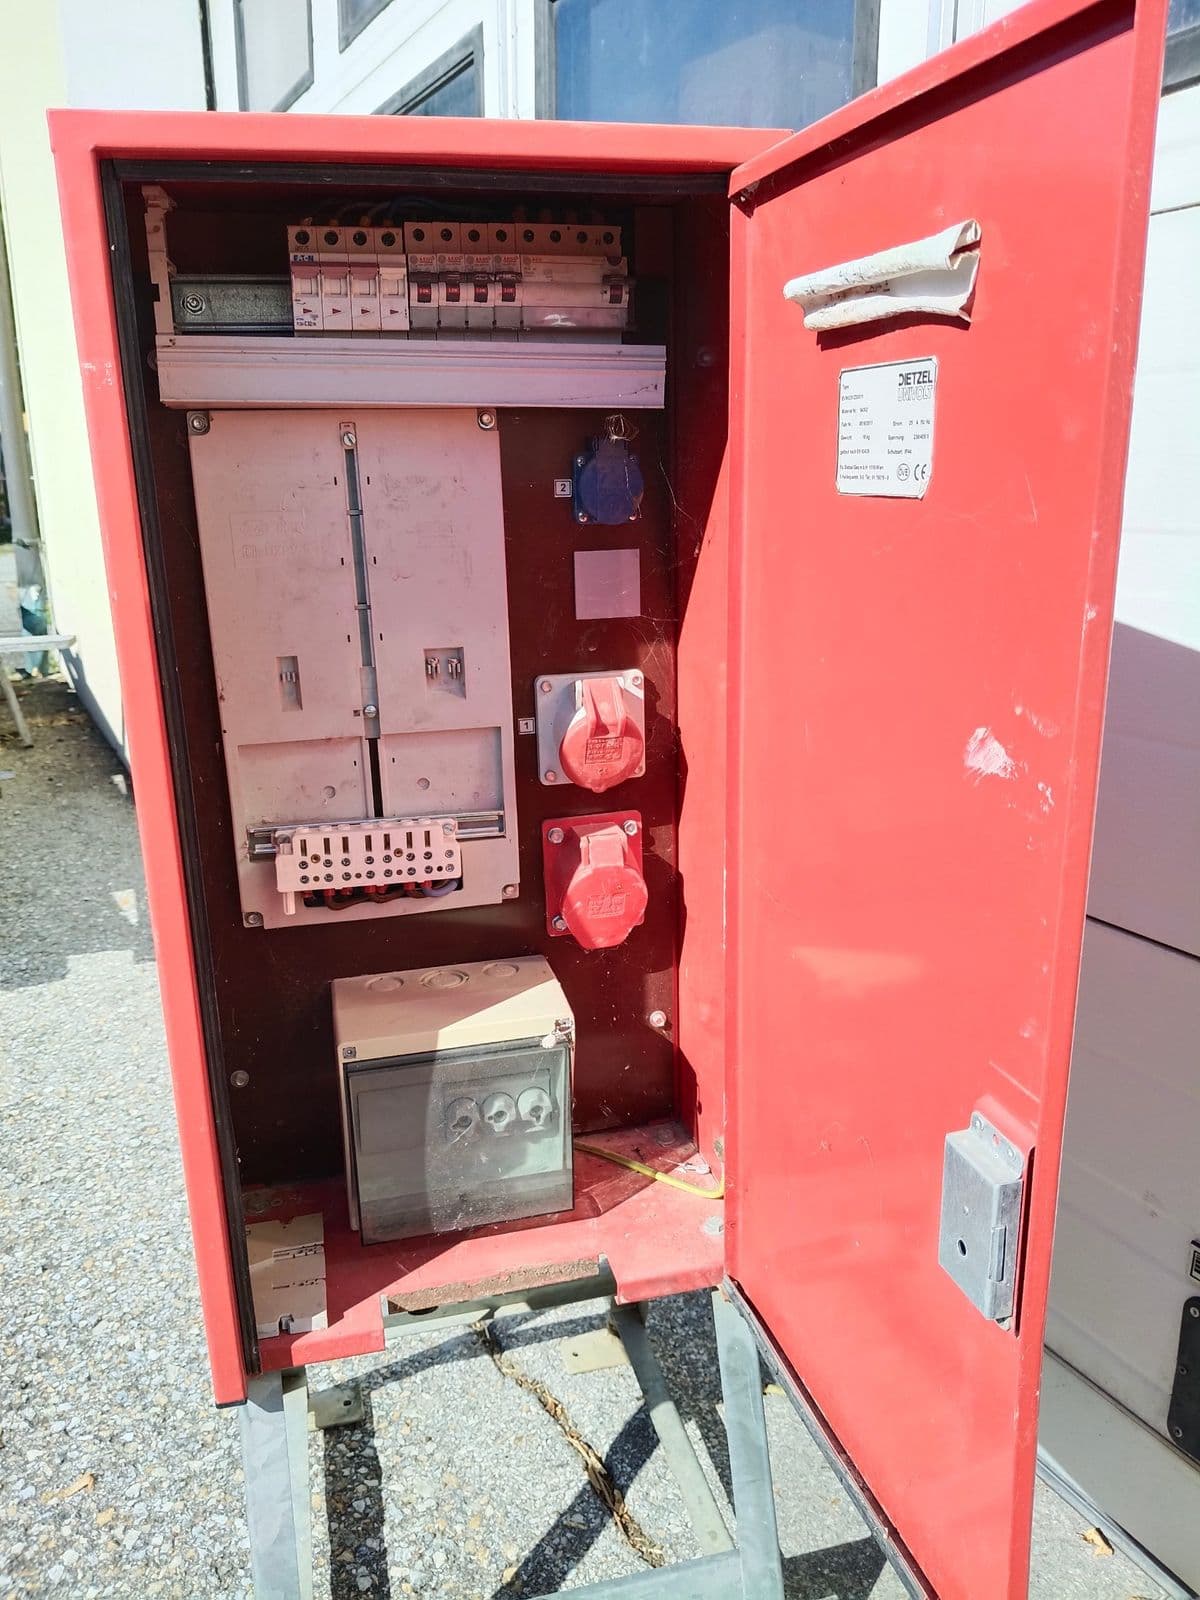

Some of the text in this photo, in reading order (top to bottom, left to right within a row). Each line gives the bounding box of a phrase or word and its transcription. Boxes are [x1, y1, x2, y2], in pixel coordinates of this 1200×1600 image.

[898, 371, 933, 386] DIETZEL
[560, 483, 567, 493] 2
[524, 721, 530, 731] 1
